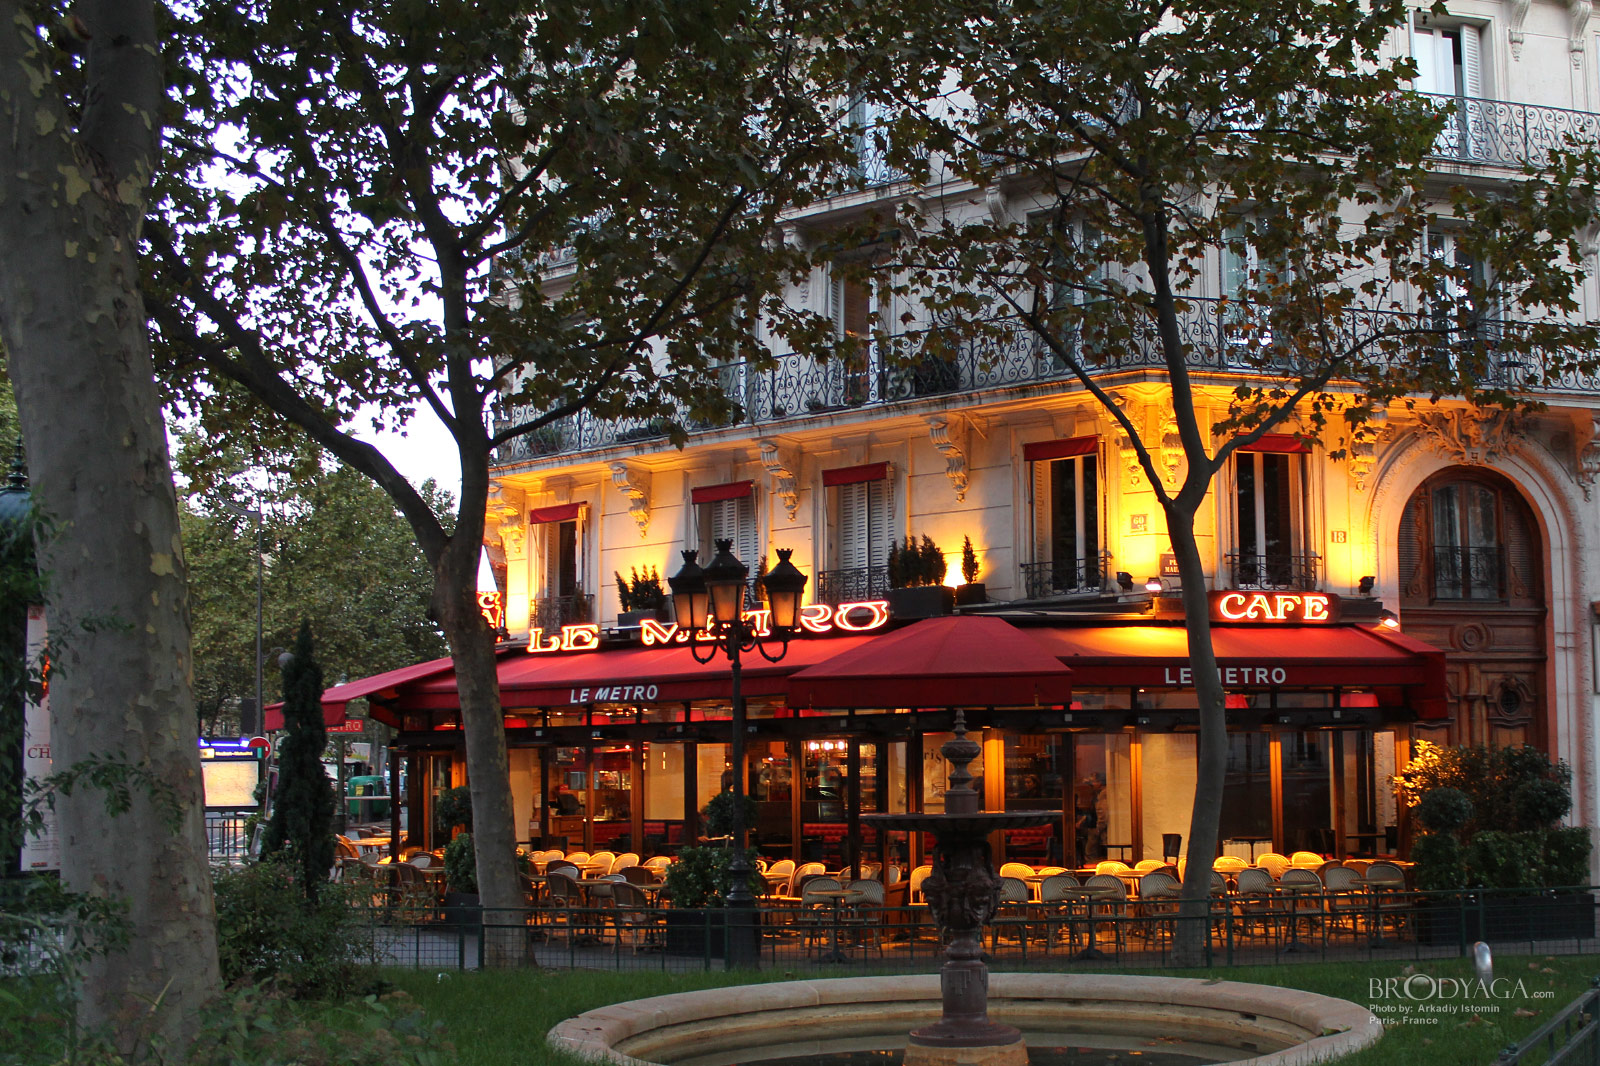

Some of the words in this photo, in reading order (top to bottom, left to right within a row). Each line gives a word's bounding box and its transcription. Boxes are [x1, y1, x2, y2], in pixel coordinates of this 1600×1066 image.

[1333, 531, 1345, 543] 18
[1219, 593, 1329, 620] CAFE
[527, 624, 599, 653] LE
[1165, 667, 1193, 684] LE
[1217, 667, 1286, 684] ETRO
[570, 688, 590, 704] LE
[594, 684, 658, 701] METRO
